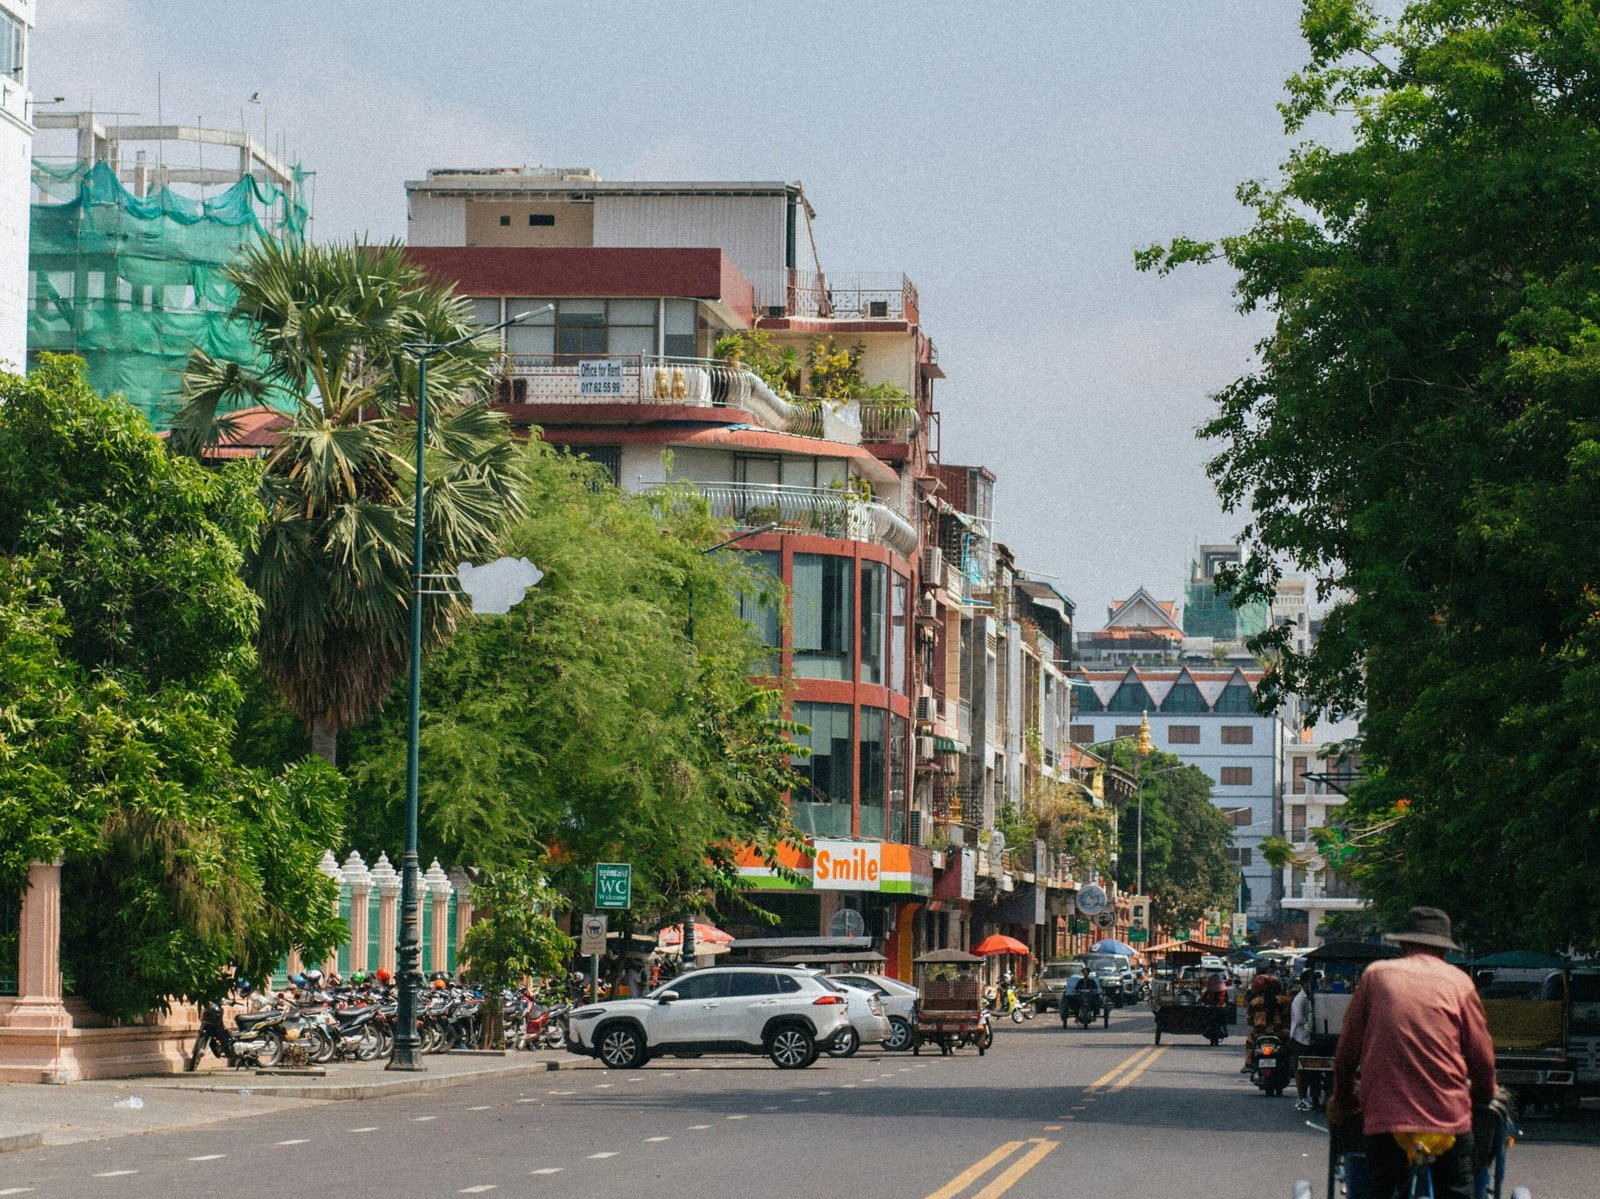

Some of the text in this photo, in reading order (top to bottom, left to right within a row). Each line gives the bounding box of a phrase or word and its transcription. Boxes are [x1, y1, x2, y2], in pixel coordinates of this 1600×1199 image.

[581, 363, 620, 377] Office for Rent
[581, 382, 620, 393] 017 62 55 99
[816, 848, 879, 881] Smile
[600, 879, 627, 894] WC
[598, 893, 627, 901] Welcome
